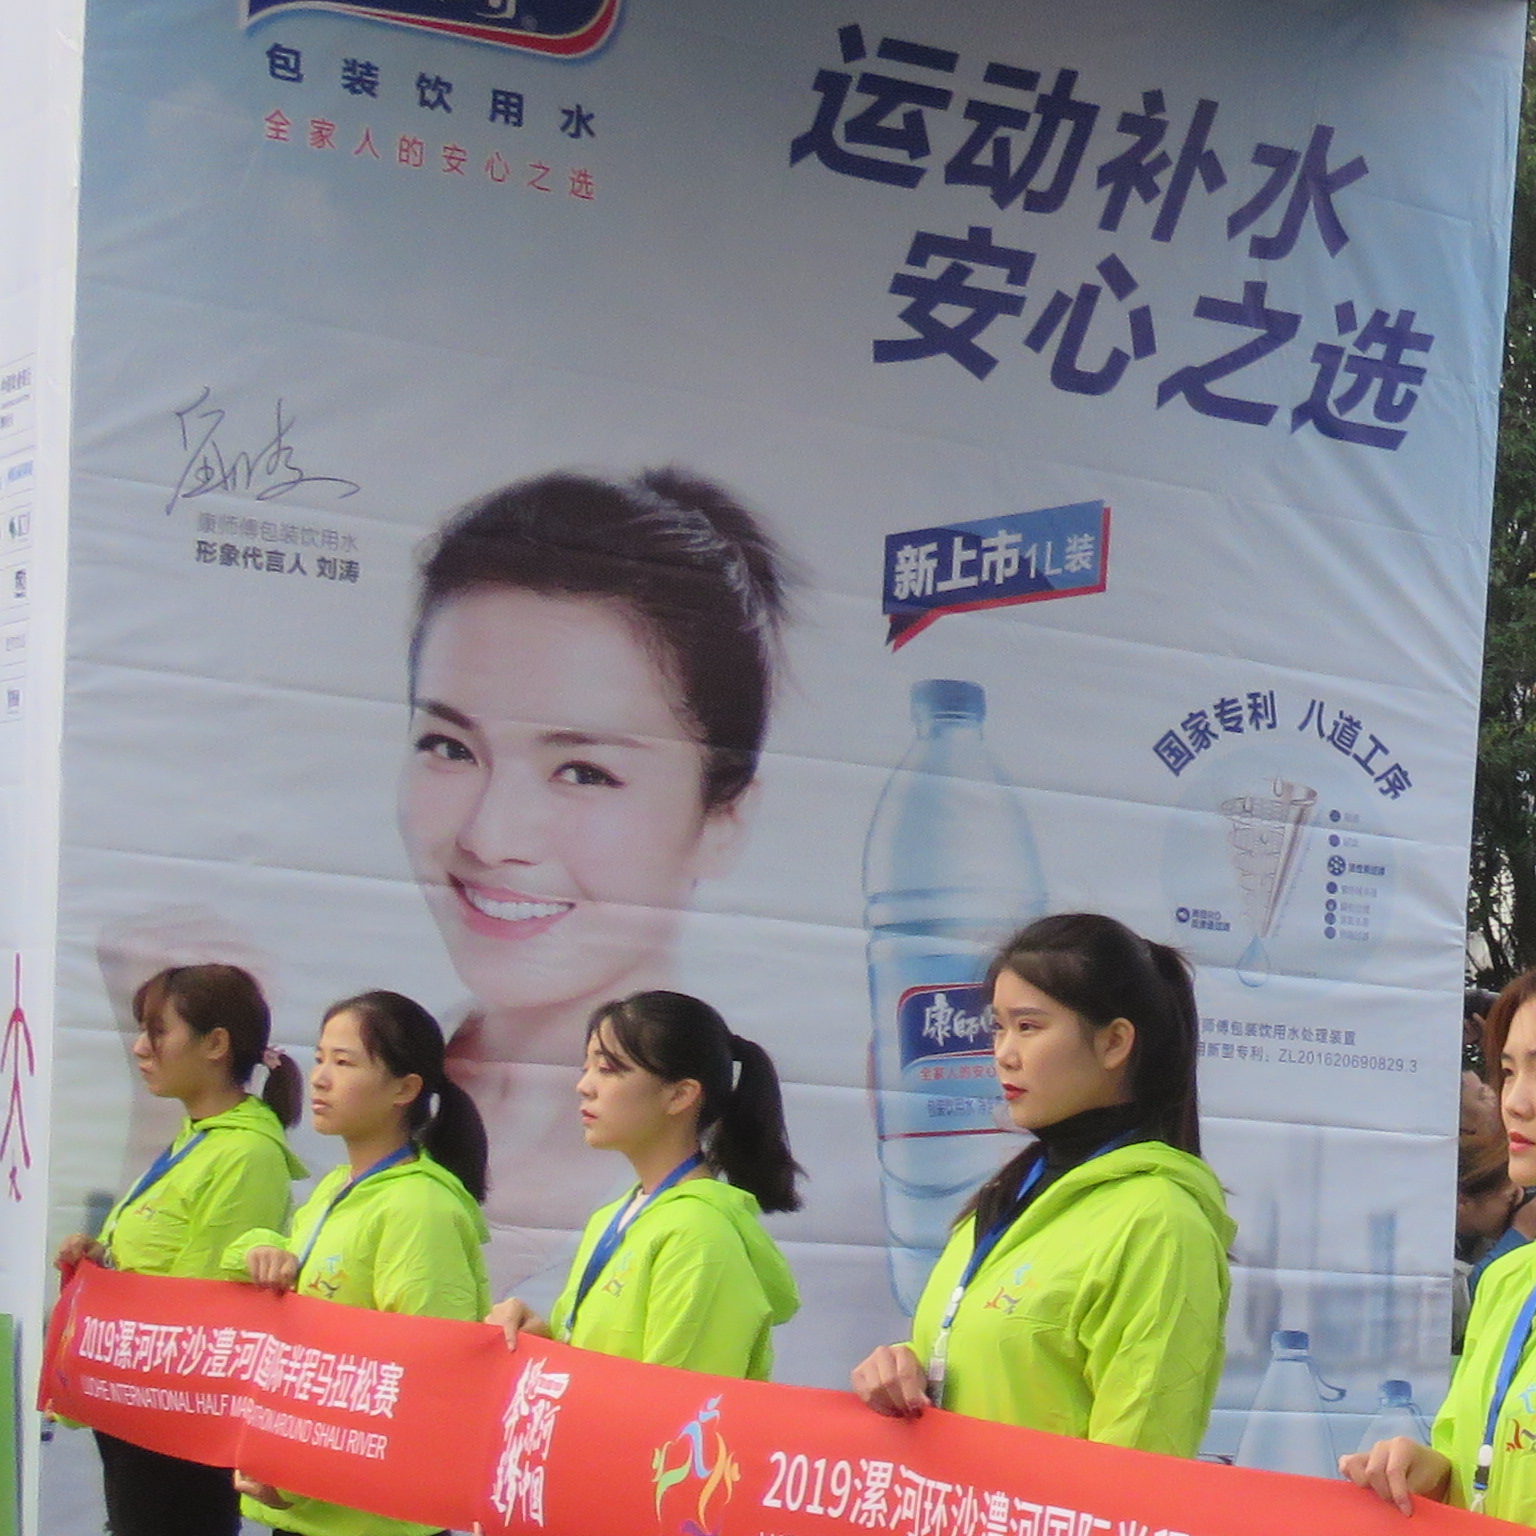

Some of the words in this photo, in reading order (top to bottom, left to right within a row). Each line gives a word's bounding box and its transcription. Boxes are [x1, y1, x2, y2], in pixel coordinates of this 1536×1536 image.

[265, 42, 596, 139] 包装饮用水
[263, 109, 596, 200] 全家人的安心之选
[790, 23, 1369, 260] 运动补水
[872, 226, 1435, 451] 安心之选
[196, 540, 307, 576] 形象代言人
[316, 556, 360, 583] 刘涛
[1153, 690, 1278, 777] 国家专利
[1298, 699, 1412, 801] 八道工序
[195, 1392, 229, 1417] HALF
[346, 1429, 389, 1461] RIVER
